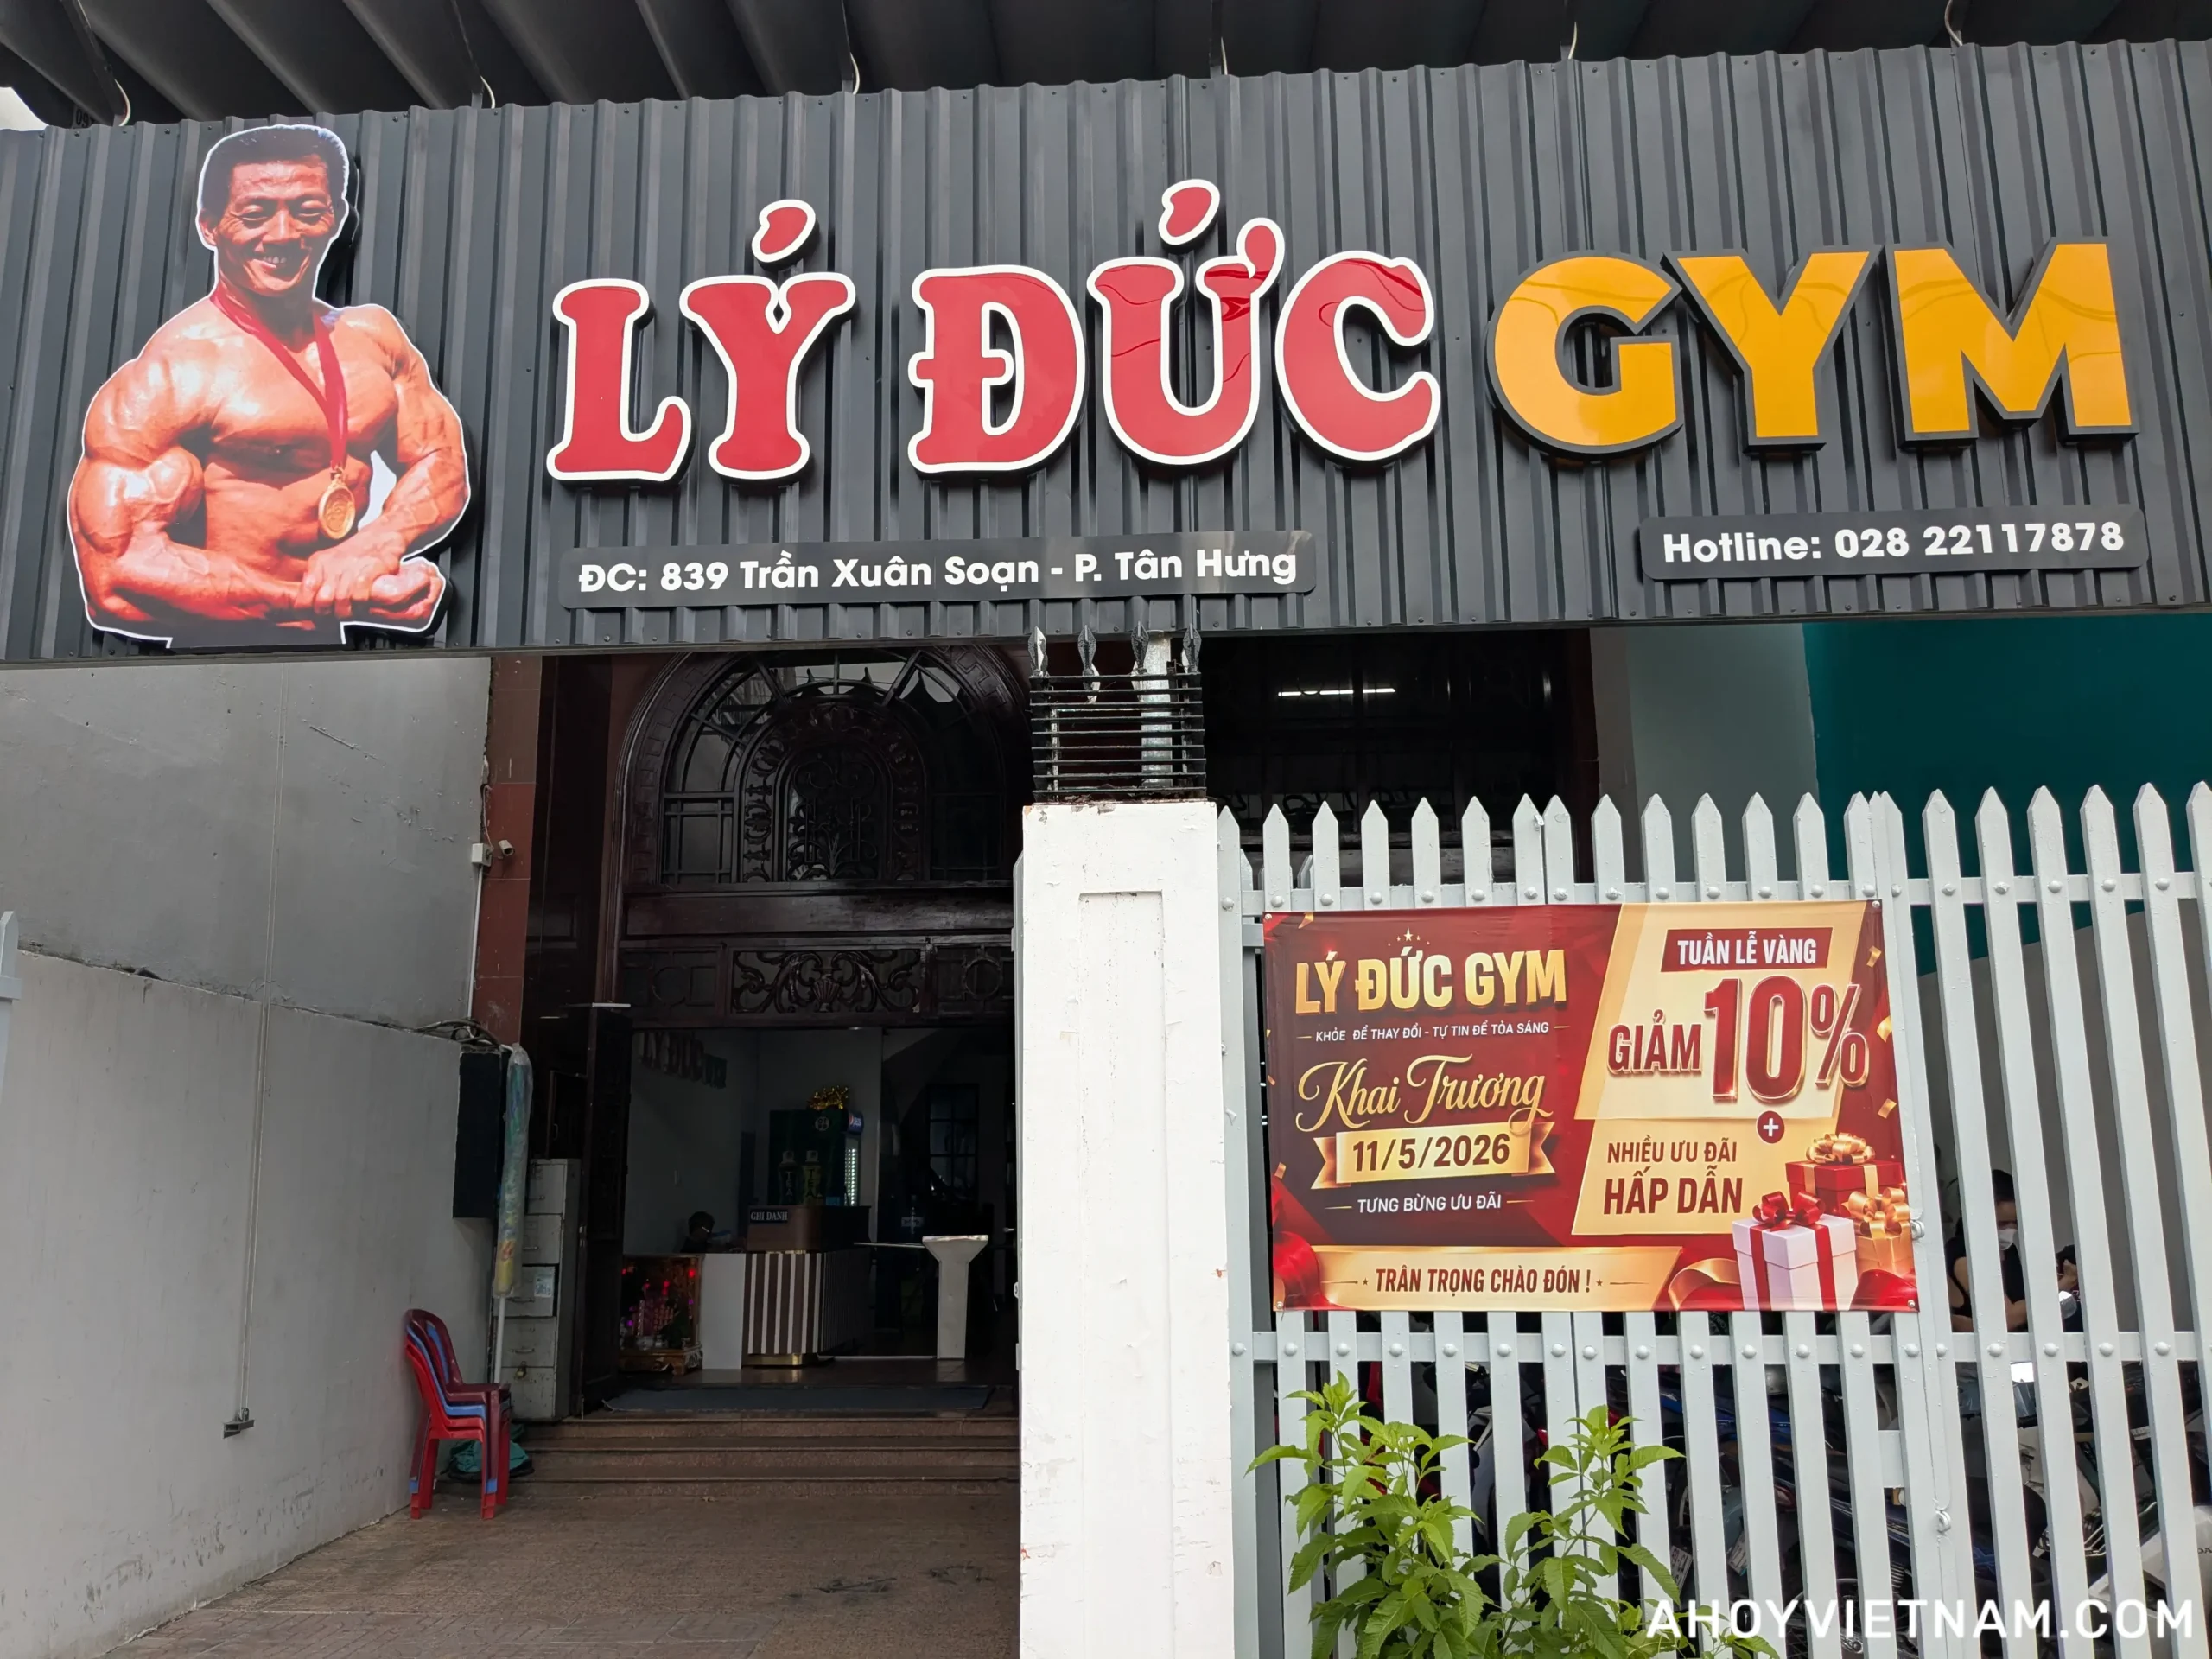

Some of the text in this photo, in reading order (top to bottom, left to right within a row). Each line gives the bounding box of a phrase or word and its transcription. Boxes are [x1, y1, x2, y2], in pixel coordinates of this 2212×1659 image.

[547, 179, 2138, 481] LÝ ĐỨC GYM
[1663, 521, 2124, 562] Hotline: 028 22117878
[579, 563, 646, 592] ĐC:
[661, 562, 728, 591] 839
[740, 550, 818, 588] Trần
[832, 556, 931, 587] Xuân
[944, 556, 1039, 592] Soạn
[1076, 553, 1102, 582] P.
[1115, 549, 1182, 580] Tân
[1197, 549, 1296, 585] Hưng
[1677, 931, 1817, 966] TUẦN LỄ VÀNG
[1295, 946, 1567, 1014] LÝ ĐỨC GYM
[1316, 1027, 1346, 1042] KHỎE
[1352, 1024, 1369, 1040] ĐỂ
[1370, 1027, 1400, 1039] THAY
[1402, 1022, 1421, 1039] ĐỔI
[1433, 1025, 1448, 1039] TỰ
[1451, 1025, 1469, 1037] TIN
[1472, 1020, 1488, 1036] ĐỂ
[1491, 1020, 1514, 1035] TỎA
[1516, 1020, 1549, 1033] SÁNG
[1607, 975, 1870, 1103] GIẢM 10%
[1295, 1053, 1554, 1135] Khai Trương
[1352, 1133, 1510, 1172] 11/5/2026
[1607, 1135, 1737, 1163] NHIỀU ƯU ĐÃI
[1357, 1191, 1502, 1213] TƯNG BỪNG ƯU ĐÃI
[1603, 1165, 1743, 1215] HẤP DẪN
[766, 1211, 788, 1221] DANH
[1376, 1264, 1592, 1297] TRÂN TRỌNG CHÀO ĐÓN !
